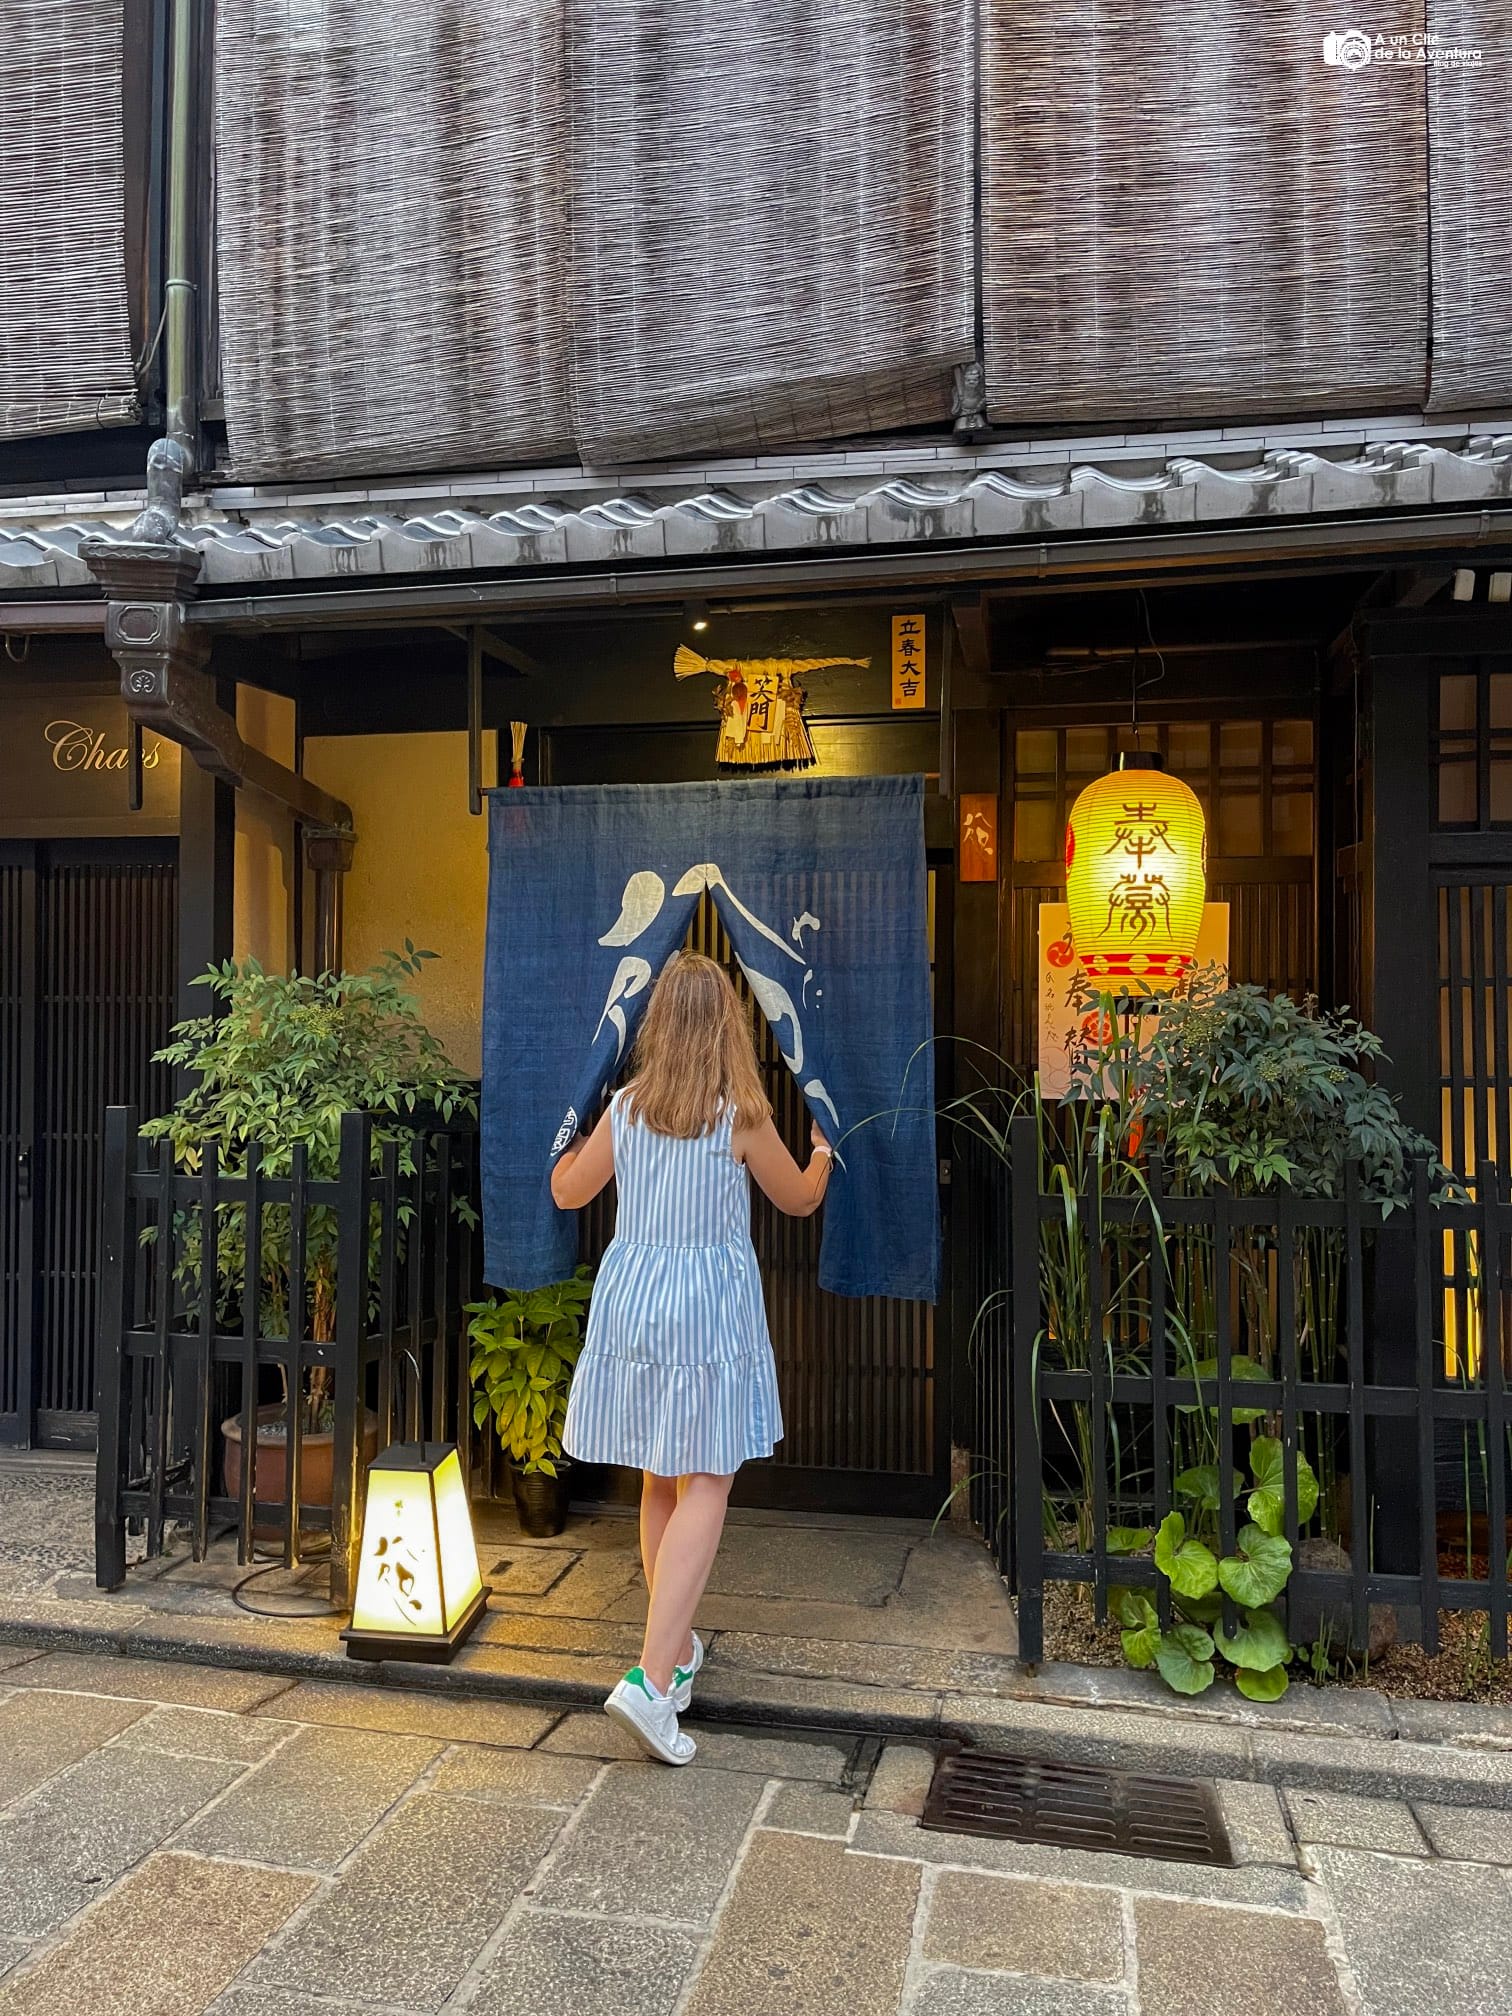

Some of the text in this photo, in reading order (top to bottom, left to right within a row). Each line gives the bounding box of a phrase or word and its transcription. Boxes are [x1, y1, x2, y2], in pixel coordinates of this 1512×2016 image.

[898, 619, 921, 697] 立春大吉
[44, 720, 161, 771] Chas
